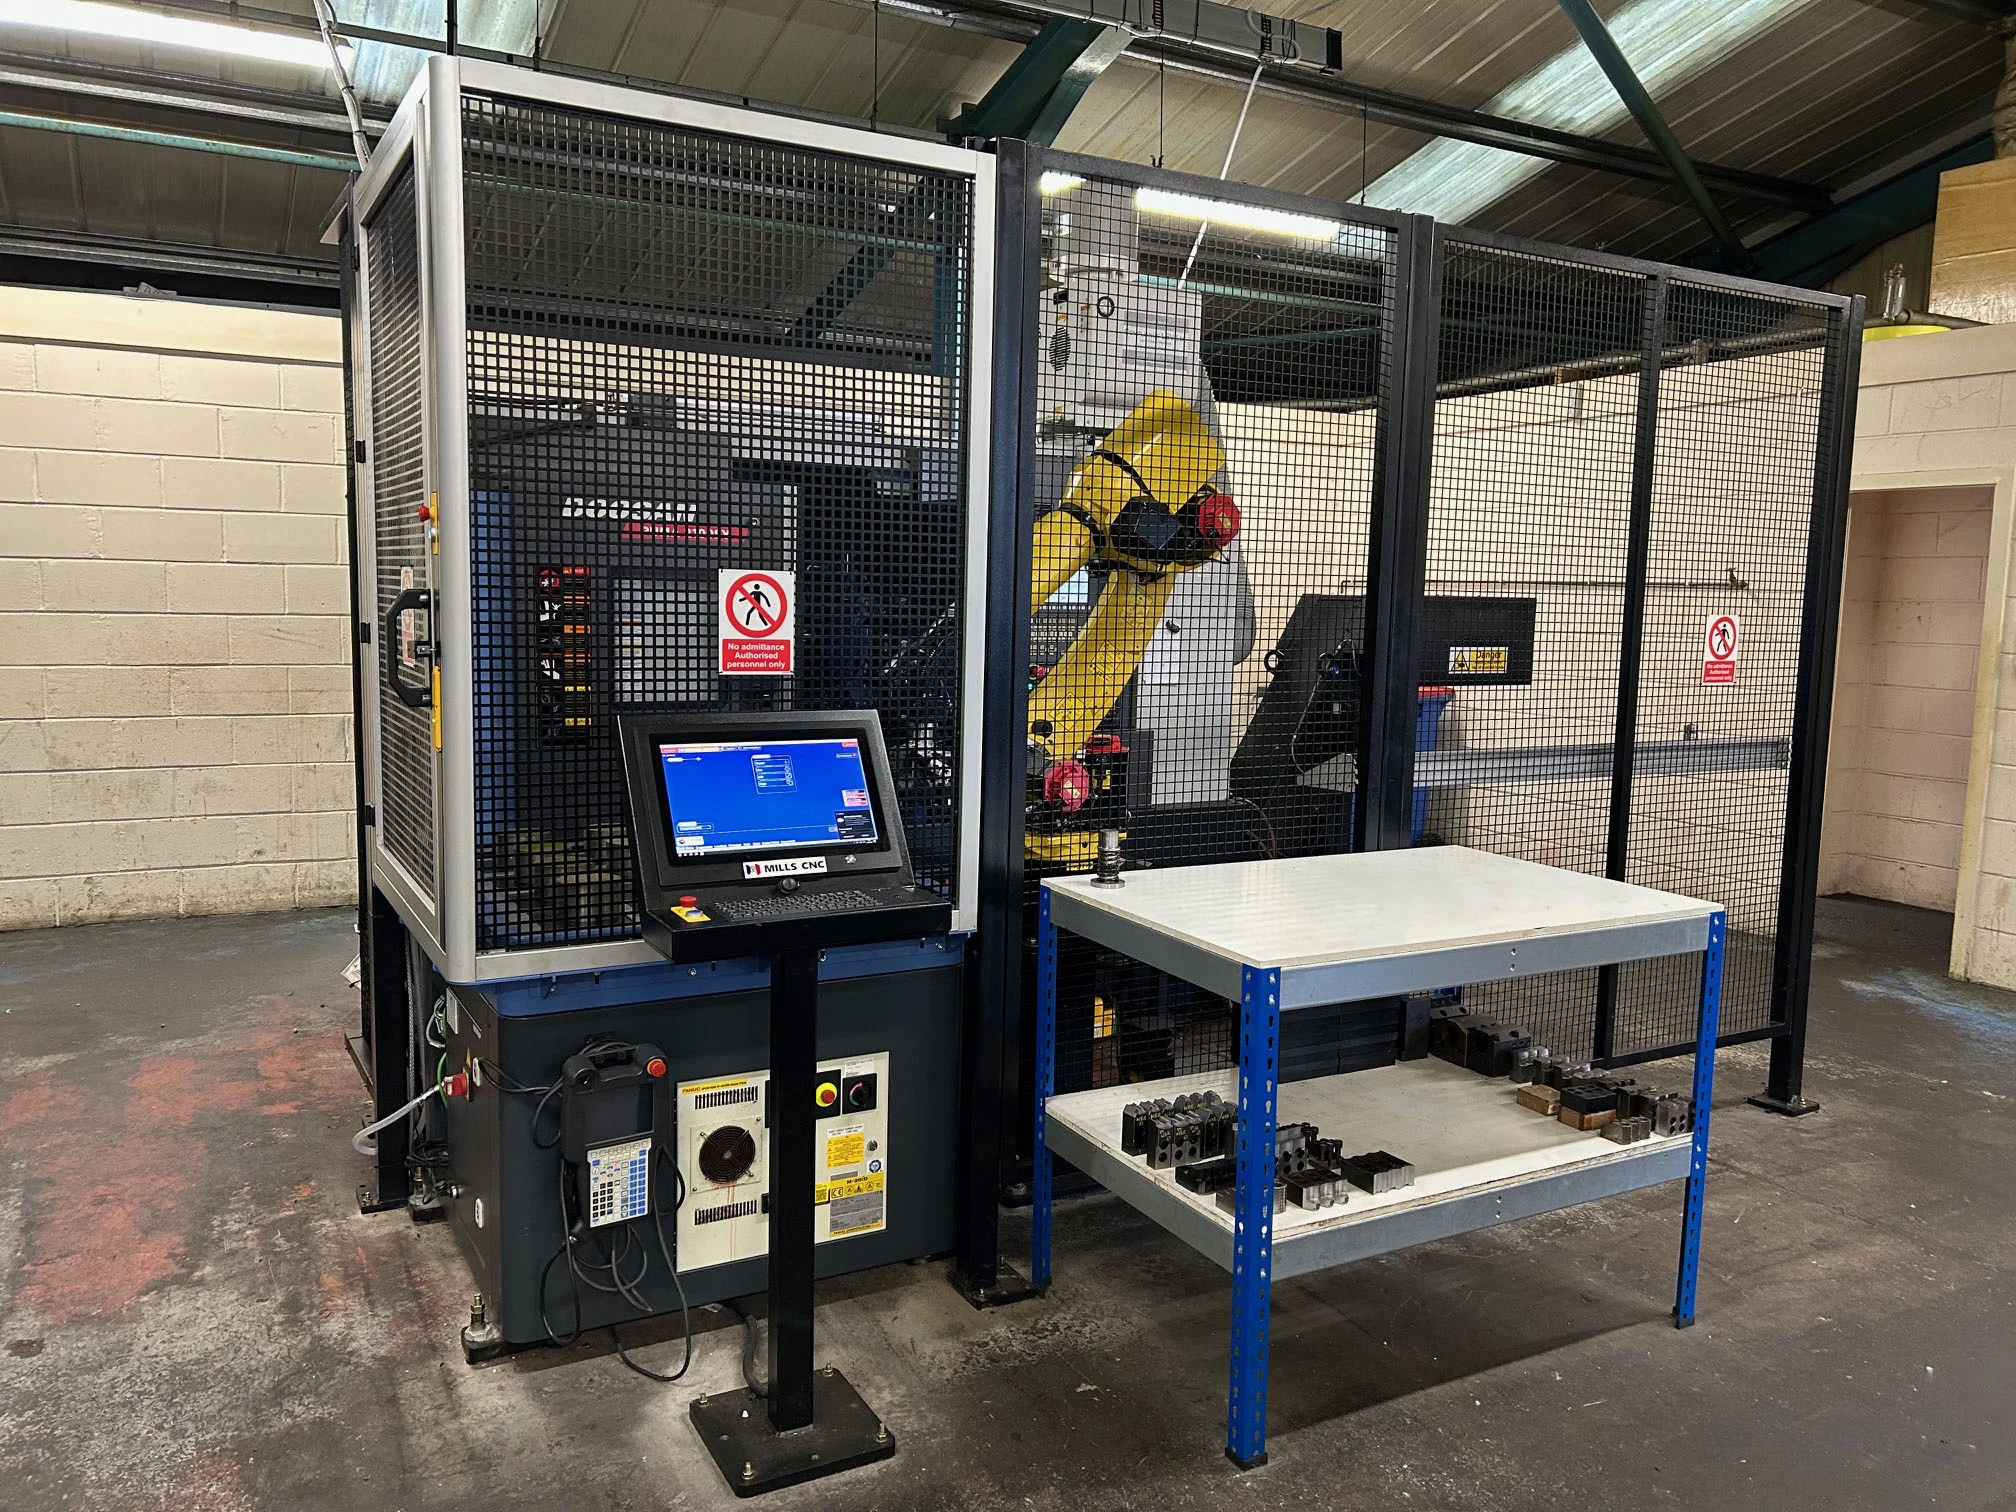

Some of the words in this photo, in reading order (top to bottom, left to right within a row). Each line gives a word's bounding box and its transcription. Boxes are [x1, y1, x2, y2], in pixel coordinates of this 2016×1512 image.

[727, 642, 740, 651] No
[741, 642, 785, 651] admittance
[734, 651, 779, 660] Authorised
[727, 660, 767, 669] personnel
[768, 660, 786, 669] only
[764, 862, 798, 873] MILLS
[801, 860, 825, 870] CNC
